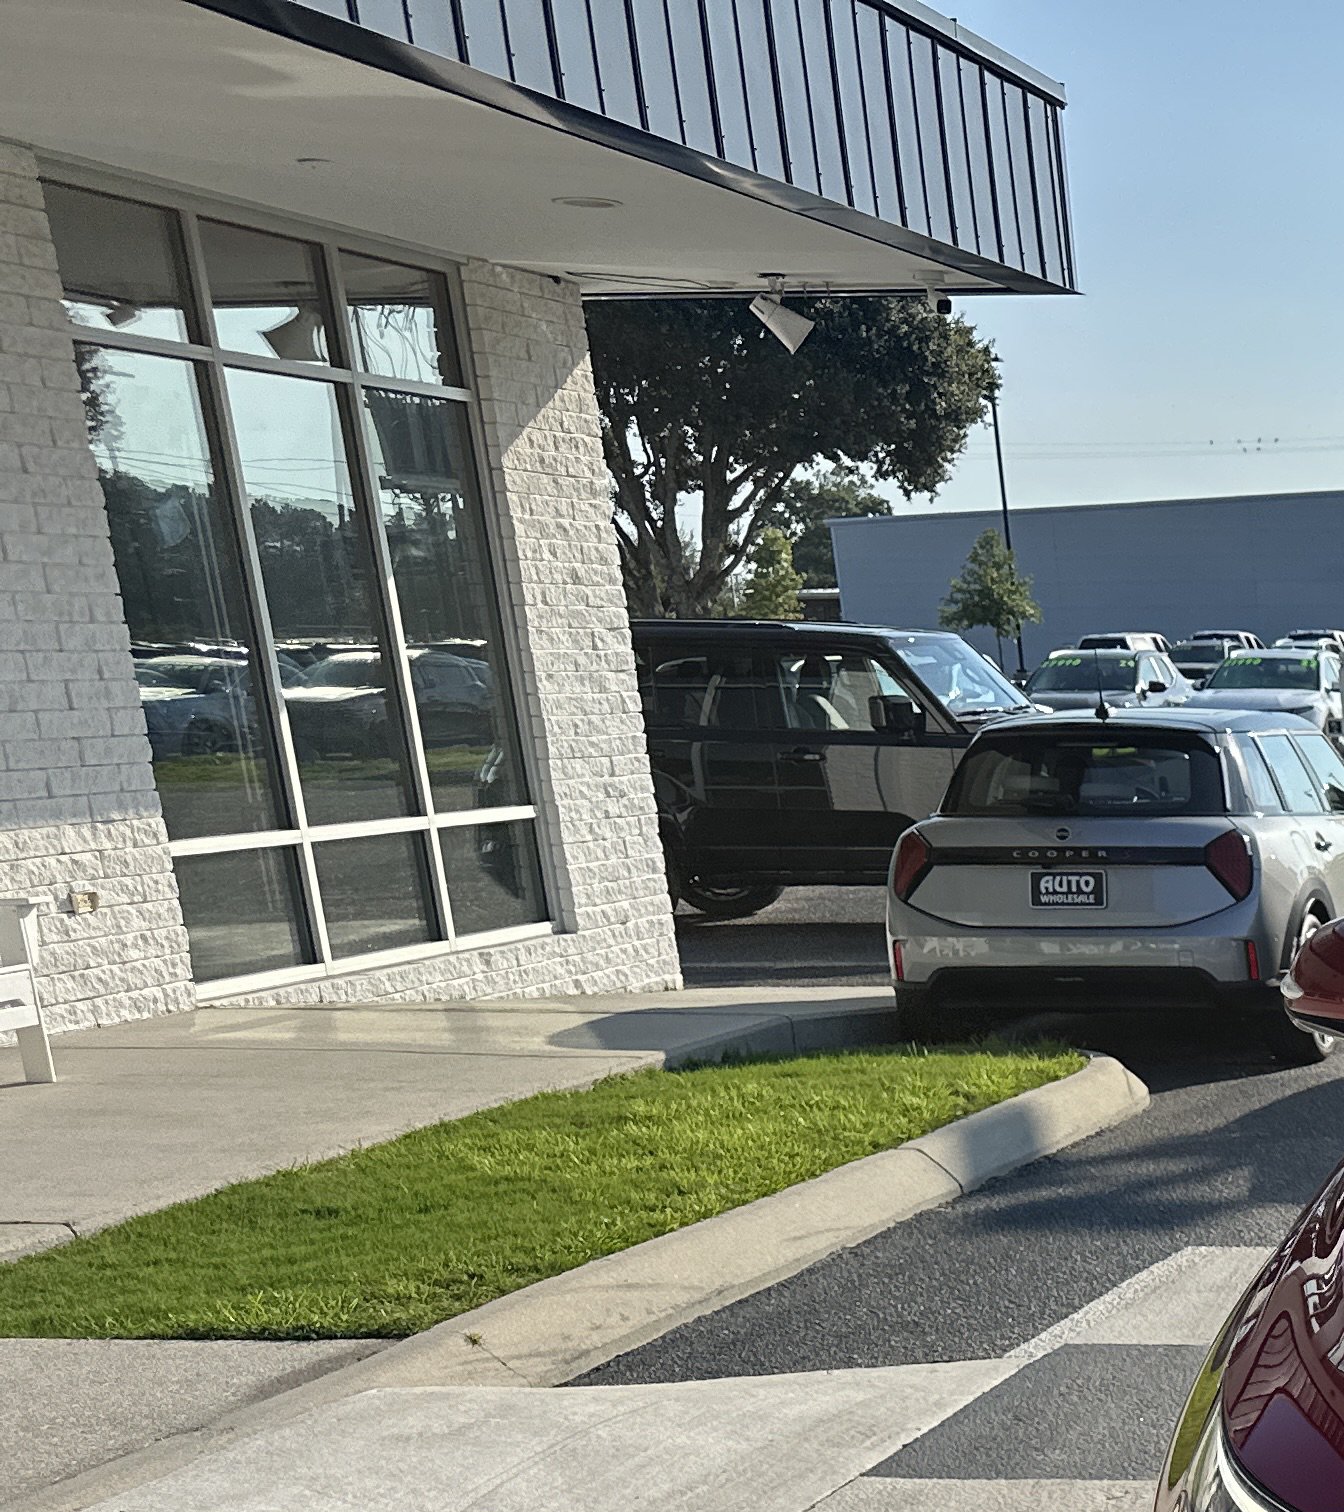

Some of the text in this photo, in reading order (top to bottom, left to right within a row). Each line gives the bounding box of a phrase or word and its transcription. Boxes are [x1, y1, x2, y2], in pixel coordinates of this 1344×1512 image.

[1012, 850, 1107, 858] COOPER
[1039, 875, 1096, 893] AUTO
[1039, 893, 1096, 904] WHOLESALE
